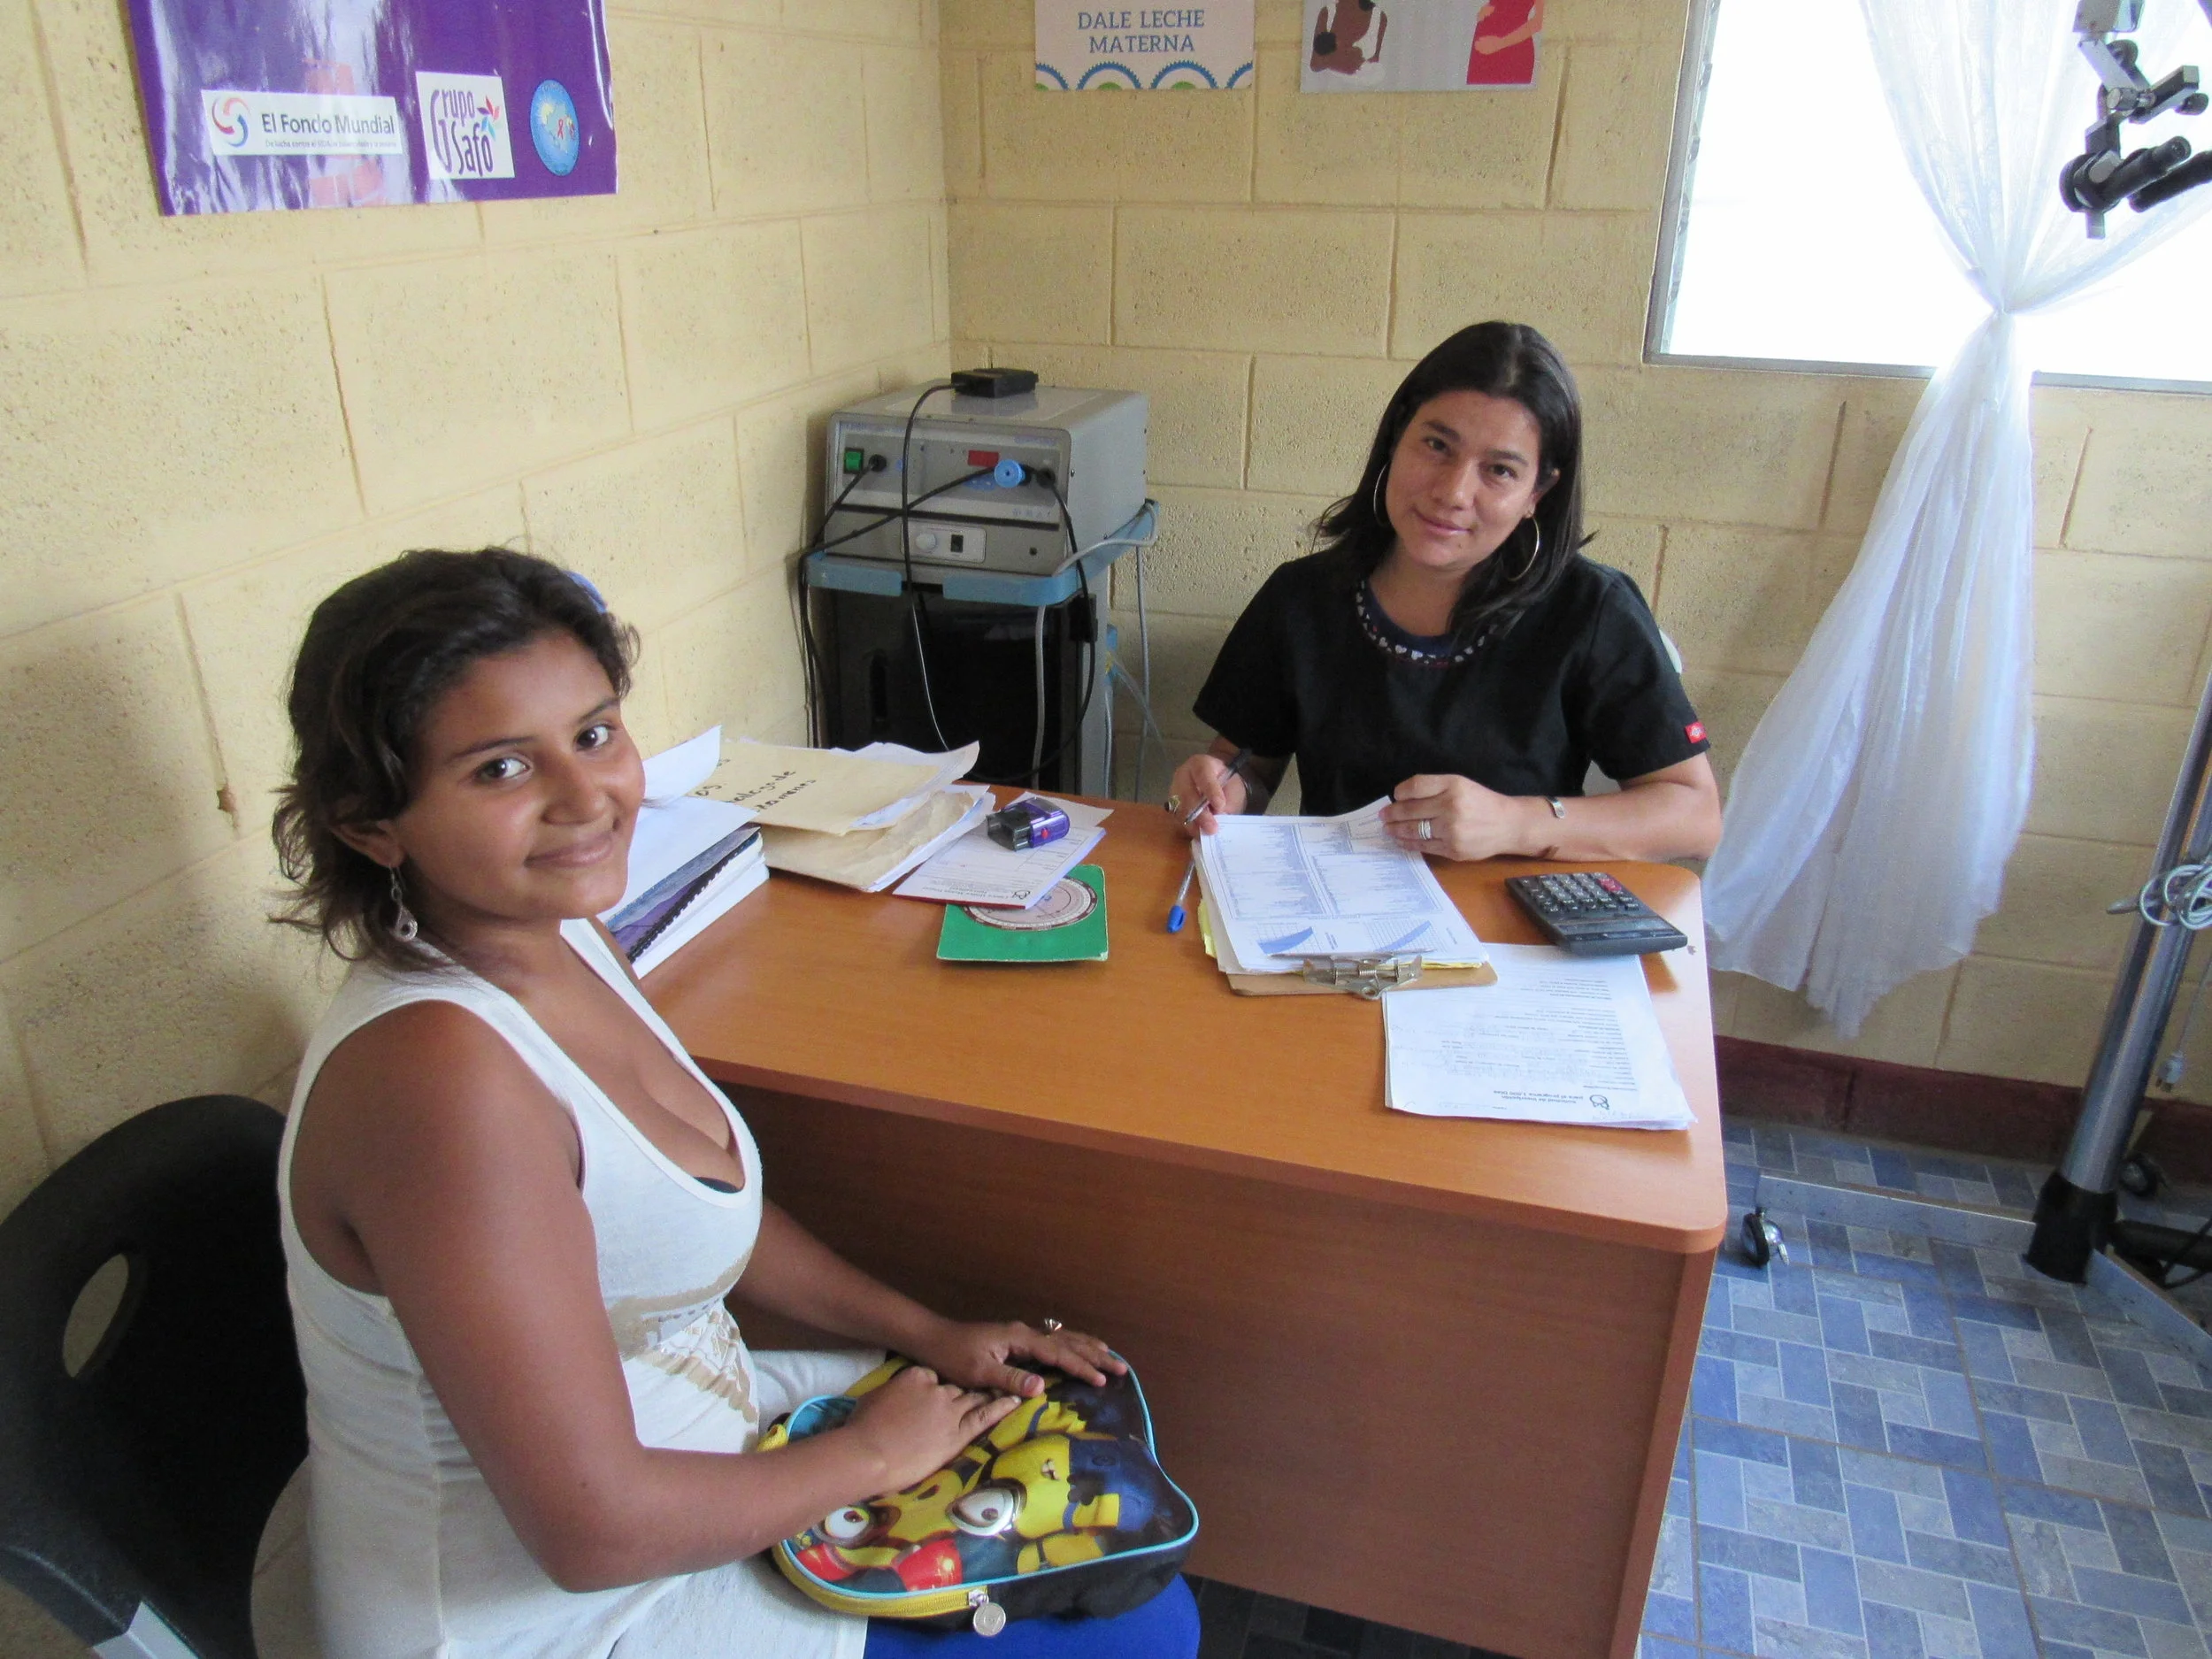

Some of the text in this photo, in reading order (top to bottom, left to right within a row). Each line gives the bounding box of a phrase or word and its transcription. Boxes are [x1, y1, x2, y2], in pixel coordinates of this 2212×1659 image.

[1078, 9, 1205, 30] DALE LECHE
[1089, 35, 1195, 53] MATERNA
[262, 112, 396, 135] El Fondo Mundial
[430, 89, 476, 173] Grupo
[451, 120, 494, 177] Safo
